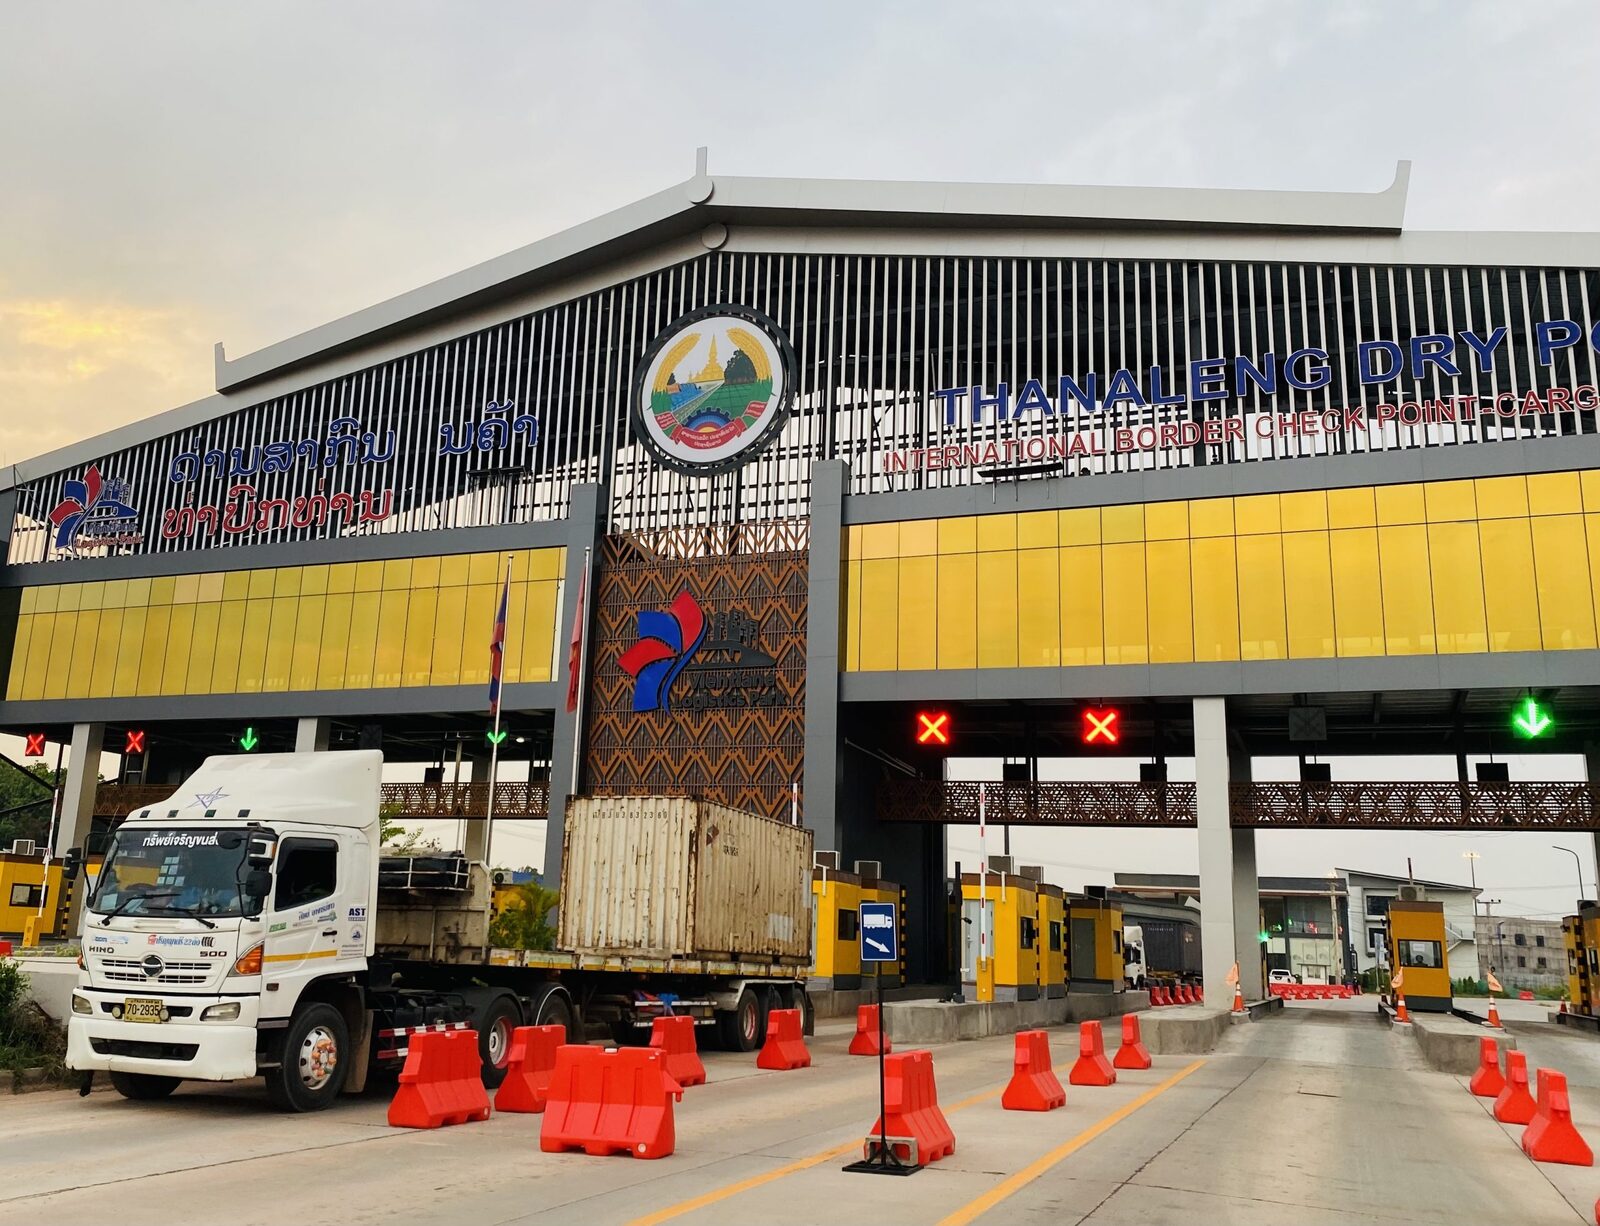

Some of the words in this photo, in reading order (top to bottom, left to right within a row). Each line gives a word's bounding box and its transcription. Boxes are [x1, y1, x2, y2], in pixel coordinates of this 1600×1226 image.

[936, 348, 1332, 427] THANALENG
[1358, 326, 1508, 386] DRY
[1535, 319, 1600, 367] P
[884, 431, 1107, 474] INTERNATIONAL
[1115, 417, 1246, 453] BORDER
[1254, 406, 1367, 440] CHECK
[348, 907, 367, 916] AST
[89, 946, 115, 954] HINO
[126, 1003, 160, 1017] 70-2935
